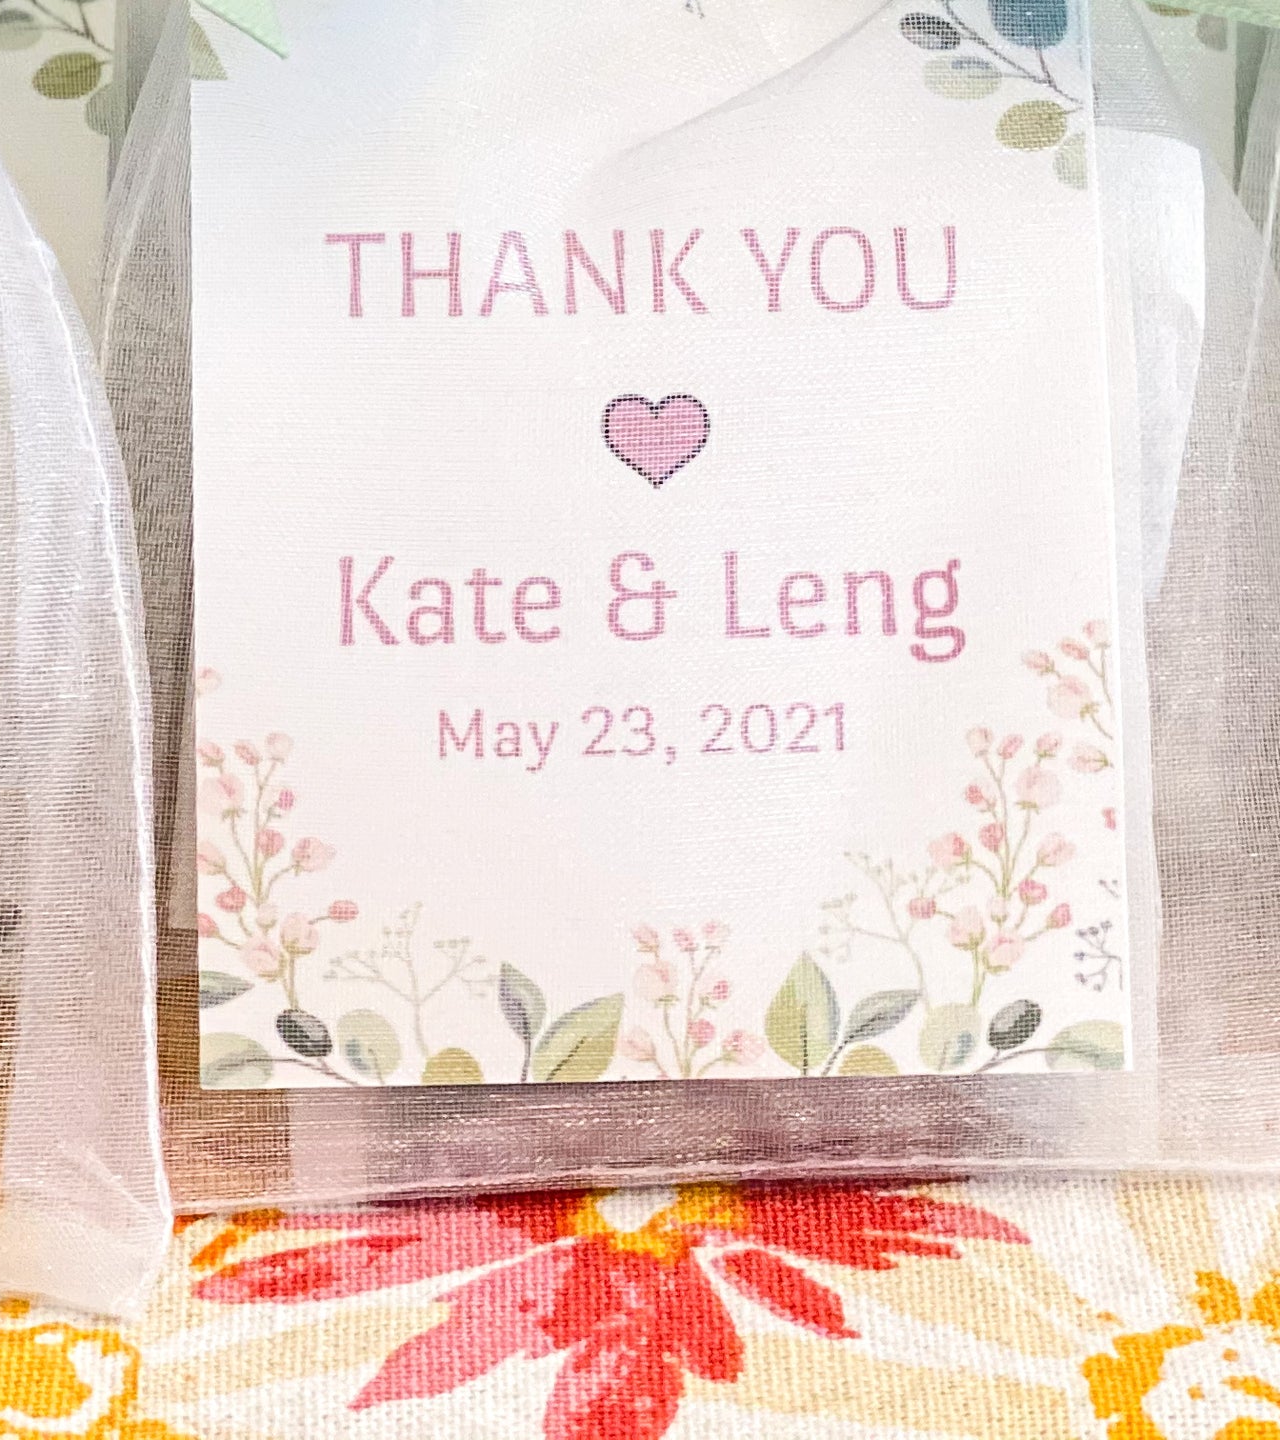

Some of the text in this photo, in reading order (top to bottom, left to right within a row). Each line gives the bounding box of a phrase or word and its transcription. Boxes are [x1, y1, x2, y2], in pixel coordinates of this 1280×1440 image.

[325, 226, 958, 318] THANK YOU
[339, 550, 966, 663] Kate & Leng
[438, 702, 846, 773] May 23, 2021
